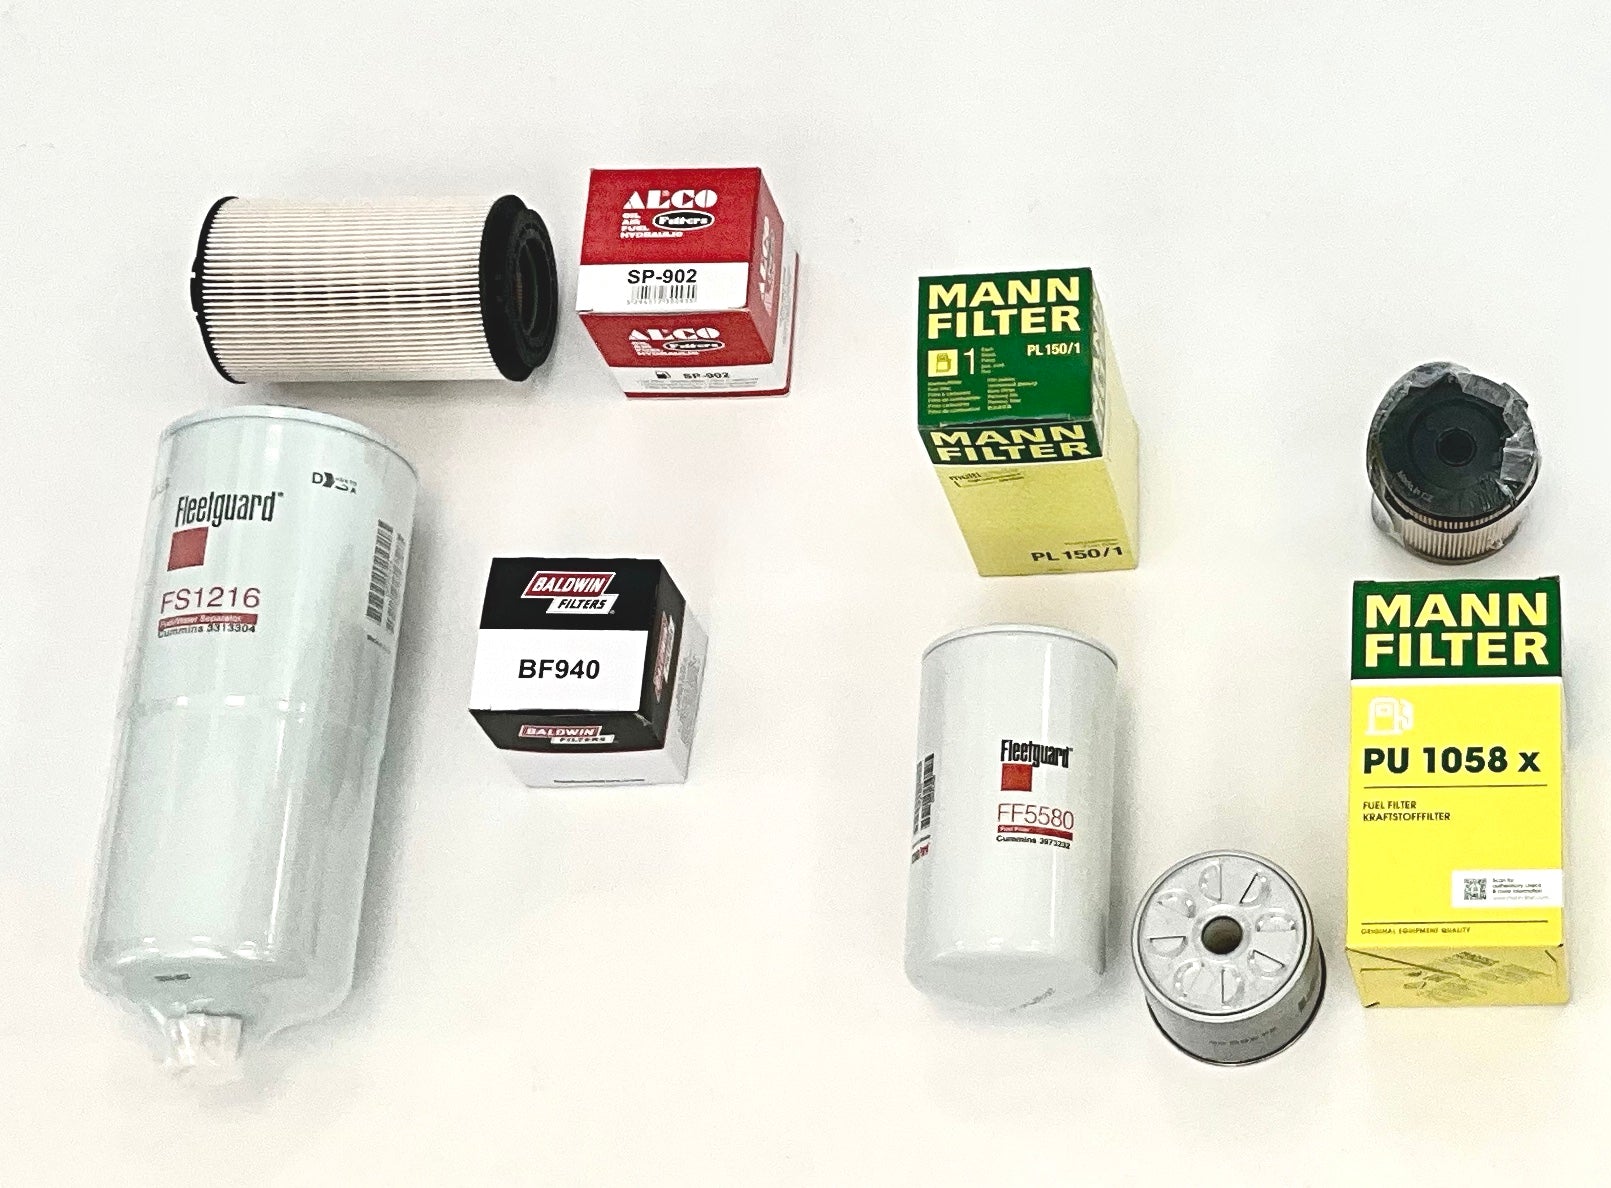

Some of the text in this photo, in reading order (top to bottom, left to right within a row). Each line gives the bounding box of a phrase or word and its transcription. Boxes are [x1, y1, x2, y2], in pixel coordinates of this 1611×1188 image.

[622, 189, 718, 209] ALCO
[627, 268, 698, 284] SP-902
[928, 276, 1081, 310] MANN
[927, 305, 1081, 339] FILTER
[628, 327, 720, 341] ALCO
[963, 347, 975, 375] 1
[1027, 344, 1044, 356] PL
[1045, 343, 1081, 355] 150/1
[930, 424, 1086, 446] MANN
[935, 441, 1092, 462] FILTER
[175, 491, 277, 527] Fleetguard
[1031, 546, 1123, 562] PL 150/1
[531, 576, 606, 593] BALDWIN
[160, 587, 261, 614] FS1216
[557, 598, 608, 610] FILTERS
[1366, 592, 1548, 628] MANN
[206, 622, 256, 633] 3313304
[1365, 631, 1550, 668] FILTER
[518, 659, 600, 680] BF940
[526, 727, 596, 737] BALDWIN
[1000, 739, 1070, 768] Fleetguard
[1363, 746, 1541, 774] PU 1058 x
[1362, 800, 1417, 810] FUEL FILTER
[997, 803, 1074, 830] FF5580
[1362, 812, 1452, 823] KRAFTSTOFFFILTER
